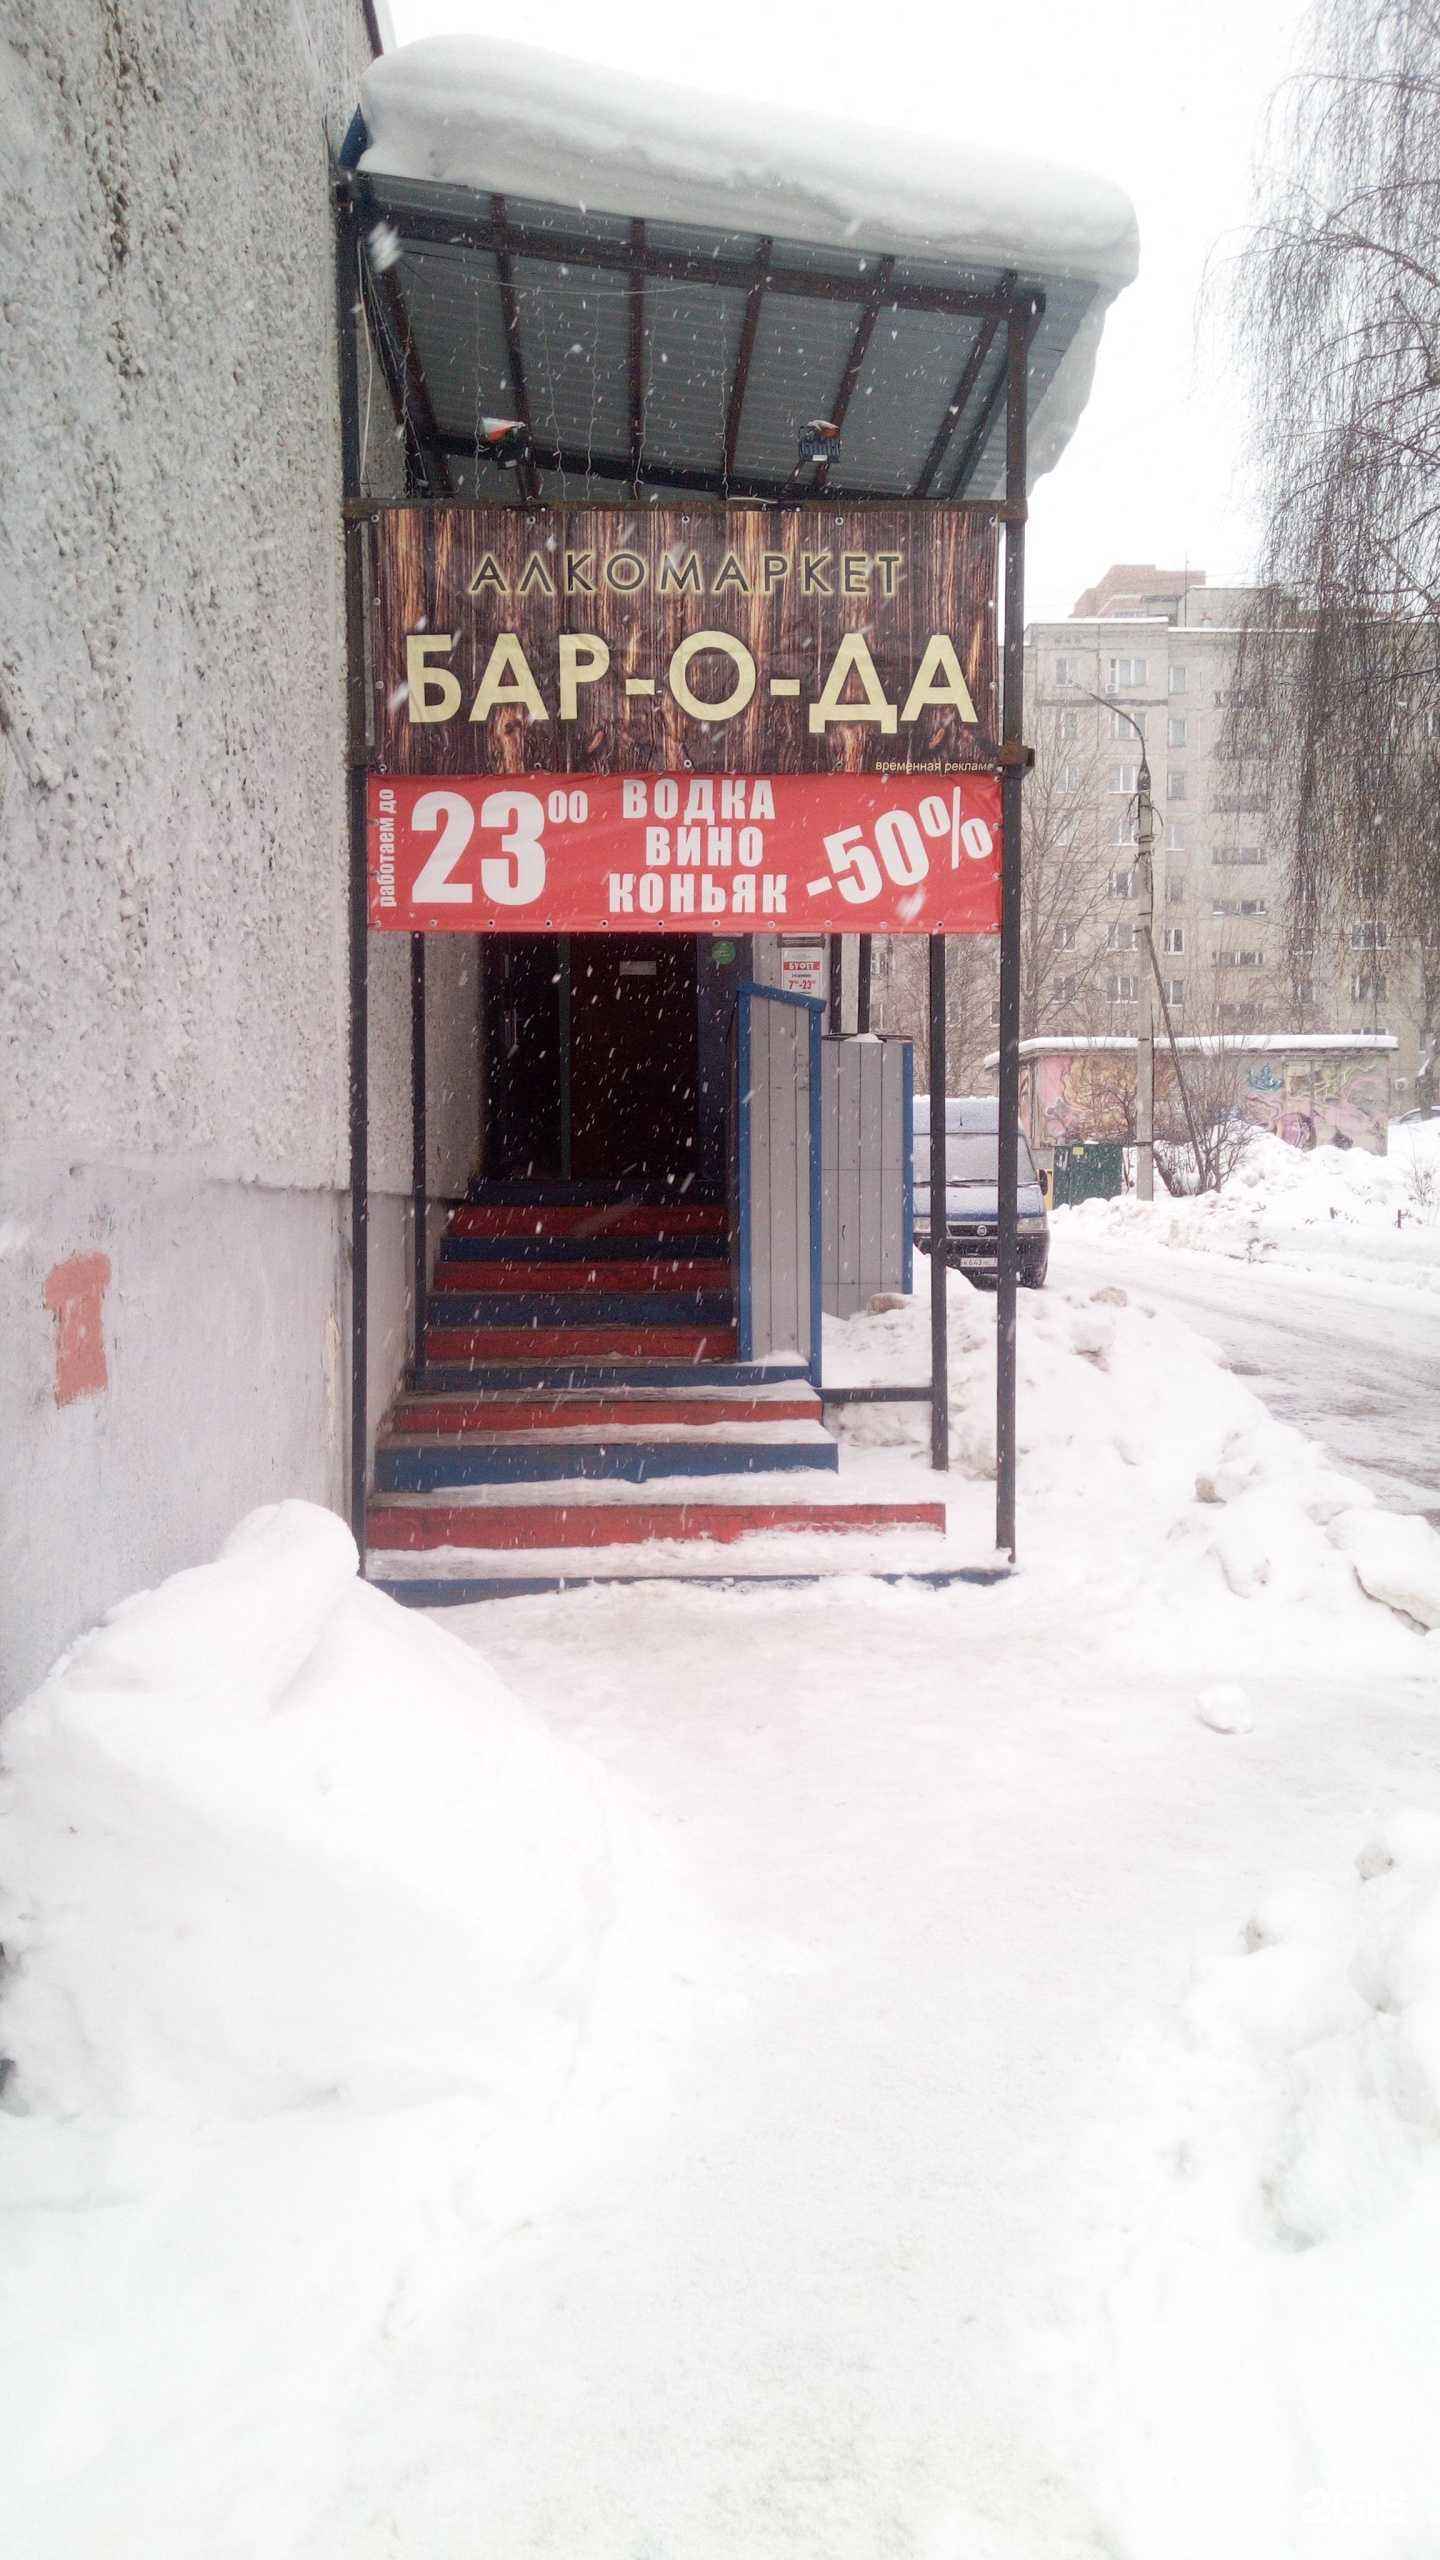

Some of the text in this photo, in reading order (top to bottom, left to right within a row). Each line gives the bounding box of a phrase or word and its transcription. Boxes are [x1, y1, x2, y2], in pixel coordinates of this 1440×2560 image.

[470, 552, 902, 595] АЛКОМАРКЕТ
[405, 630, 979, 735] БАР-О-ДА
[875, 761, 942, 774] временная
[622, 779, 776, 826] ВОДКА
[379, 788, 397, 908] работаем до
[645, 826, 764, 868] ВИНО
[807, 786, 993, 904] -50%
[608, 873, 788, 913] КОНЬЯК
